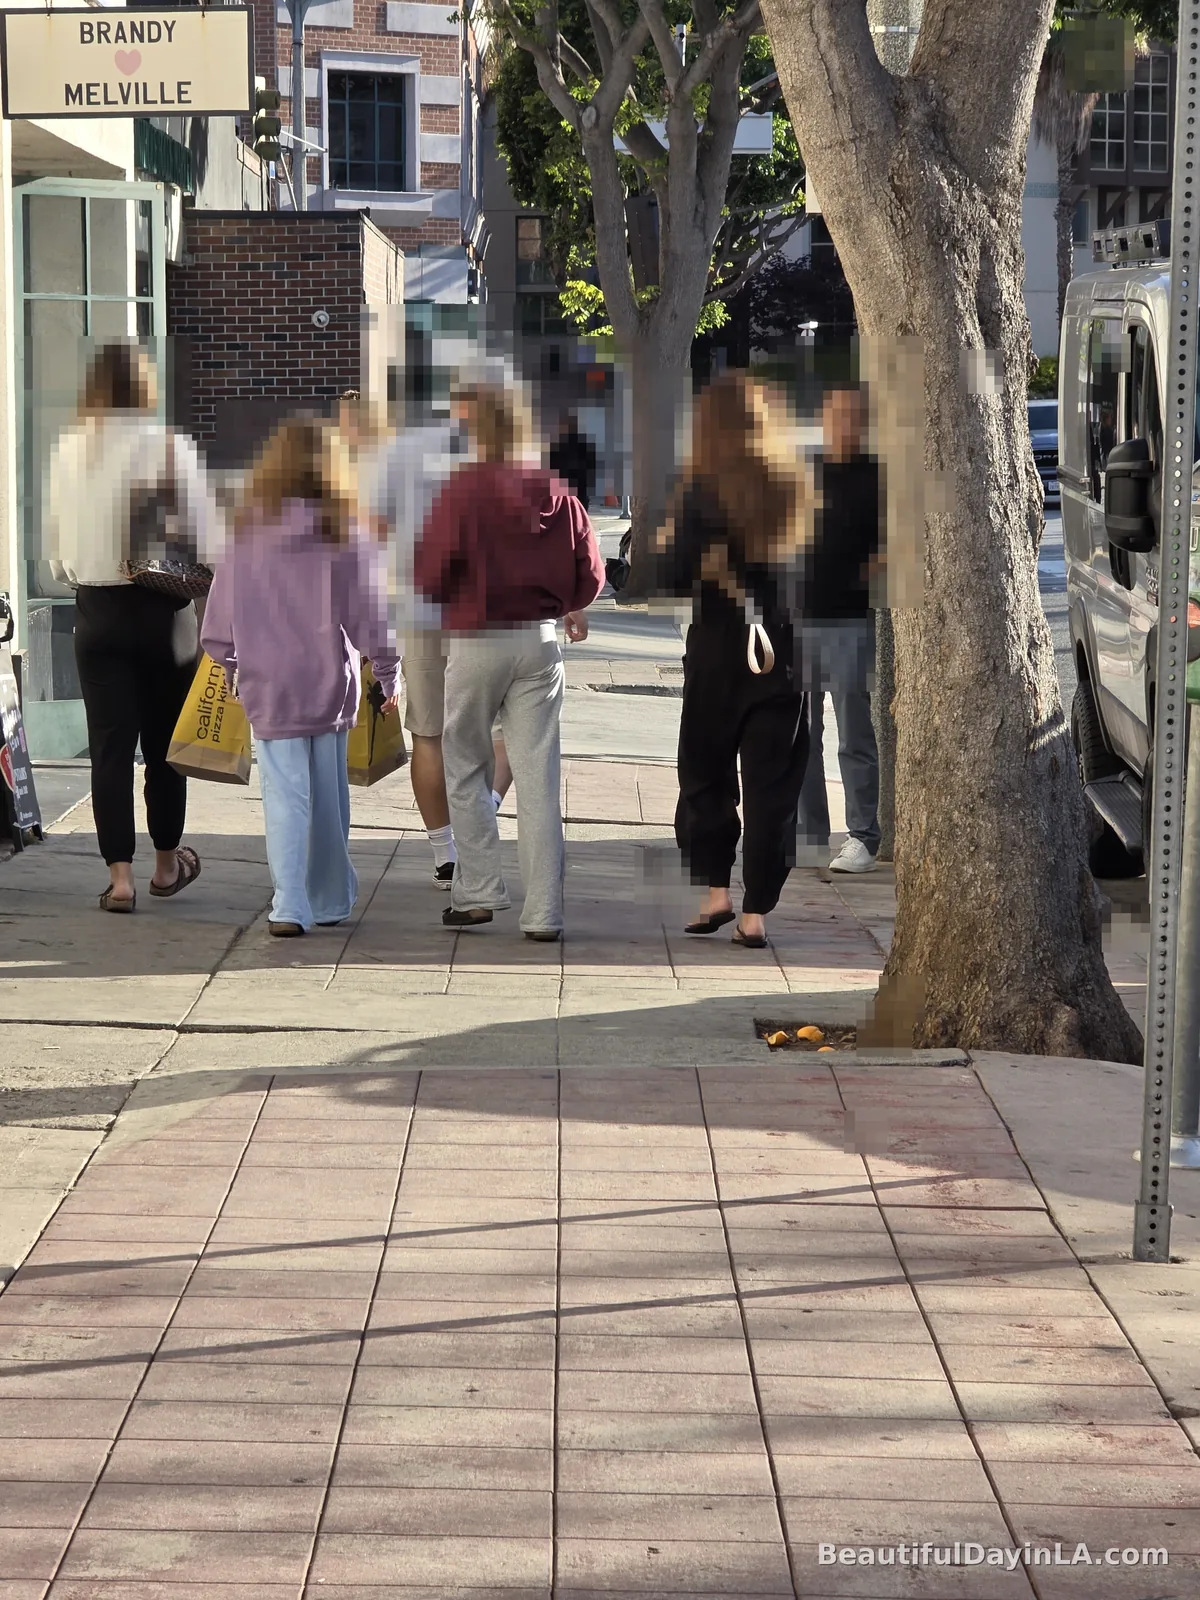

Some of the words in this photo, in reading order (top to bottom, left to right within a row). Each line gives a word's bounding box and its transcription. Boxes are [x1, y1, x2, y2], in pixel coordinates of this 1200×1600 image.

[80, 20, 176, 44] BRANDY
[65, 81, 192, 106] MELVILLE
[197, 660, 222, 739] californi
[210, 706, 225, 743] pizza
